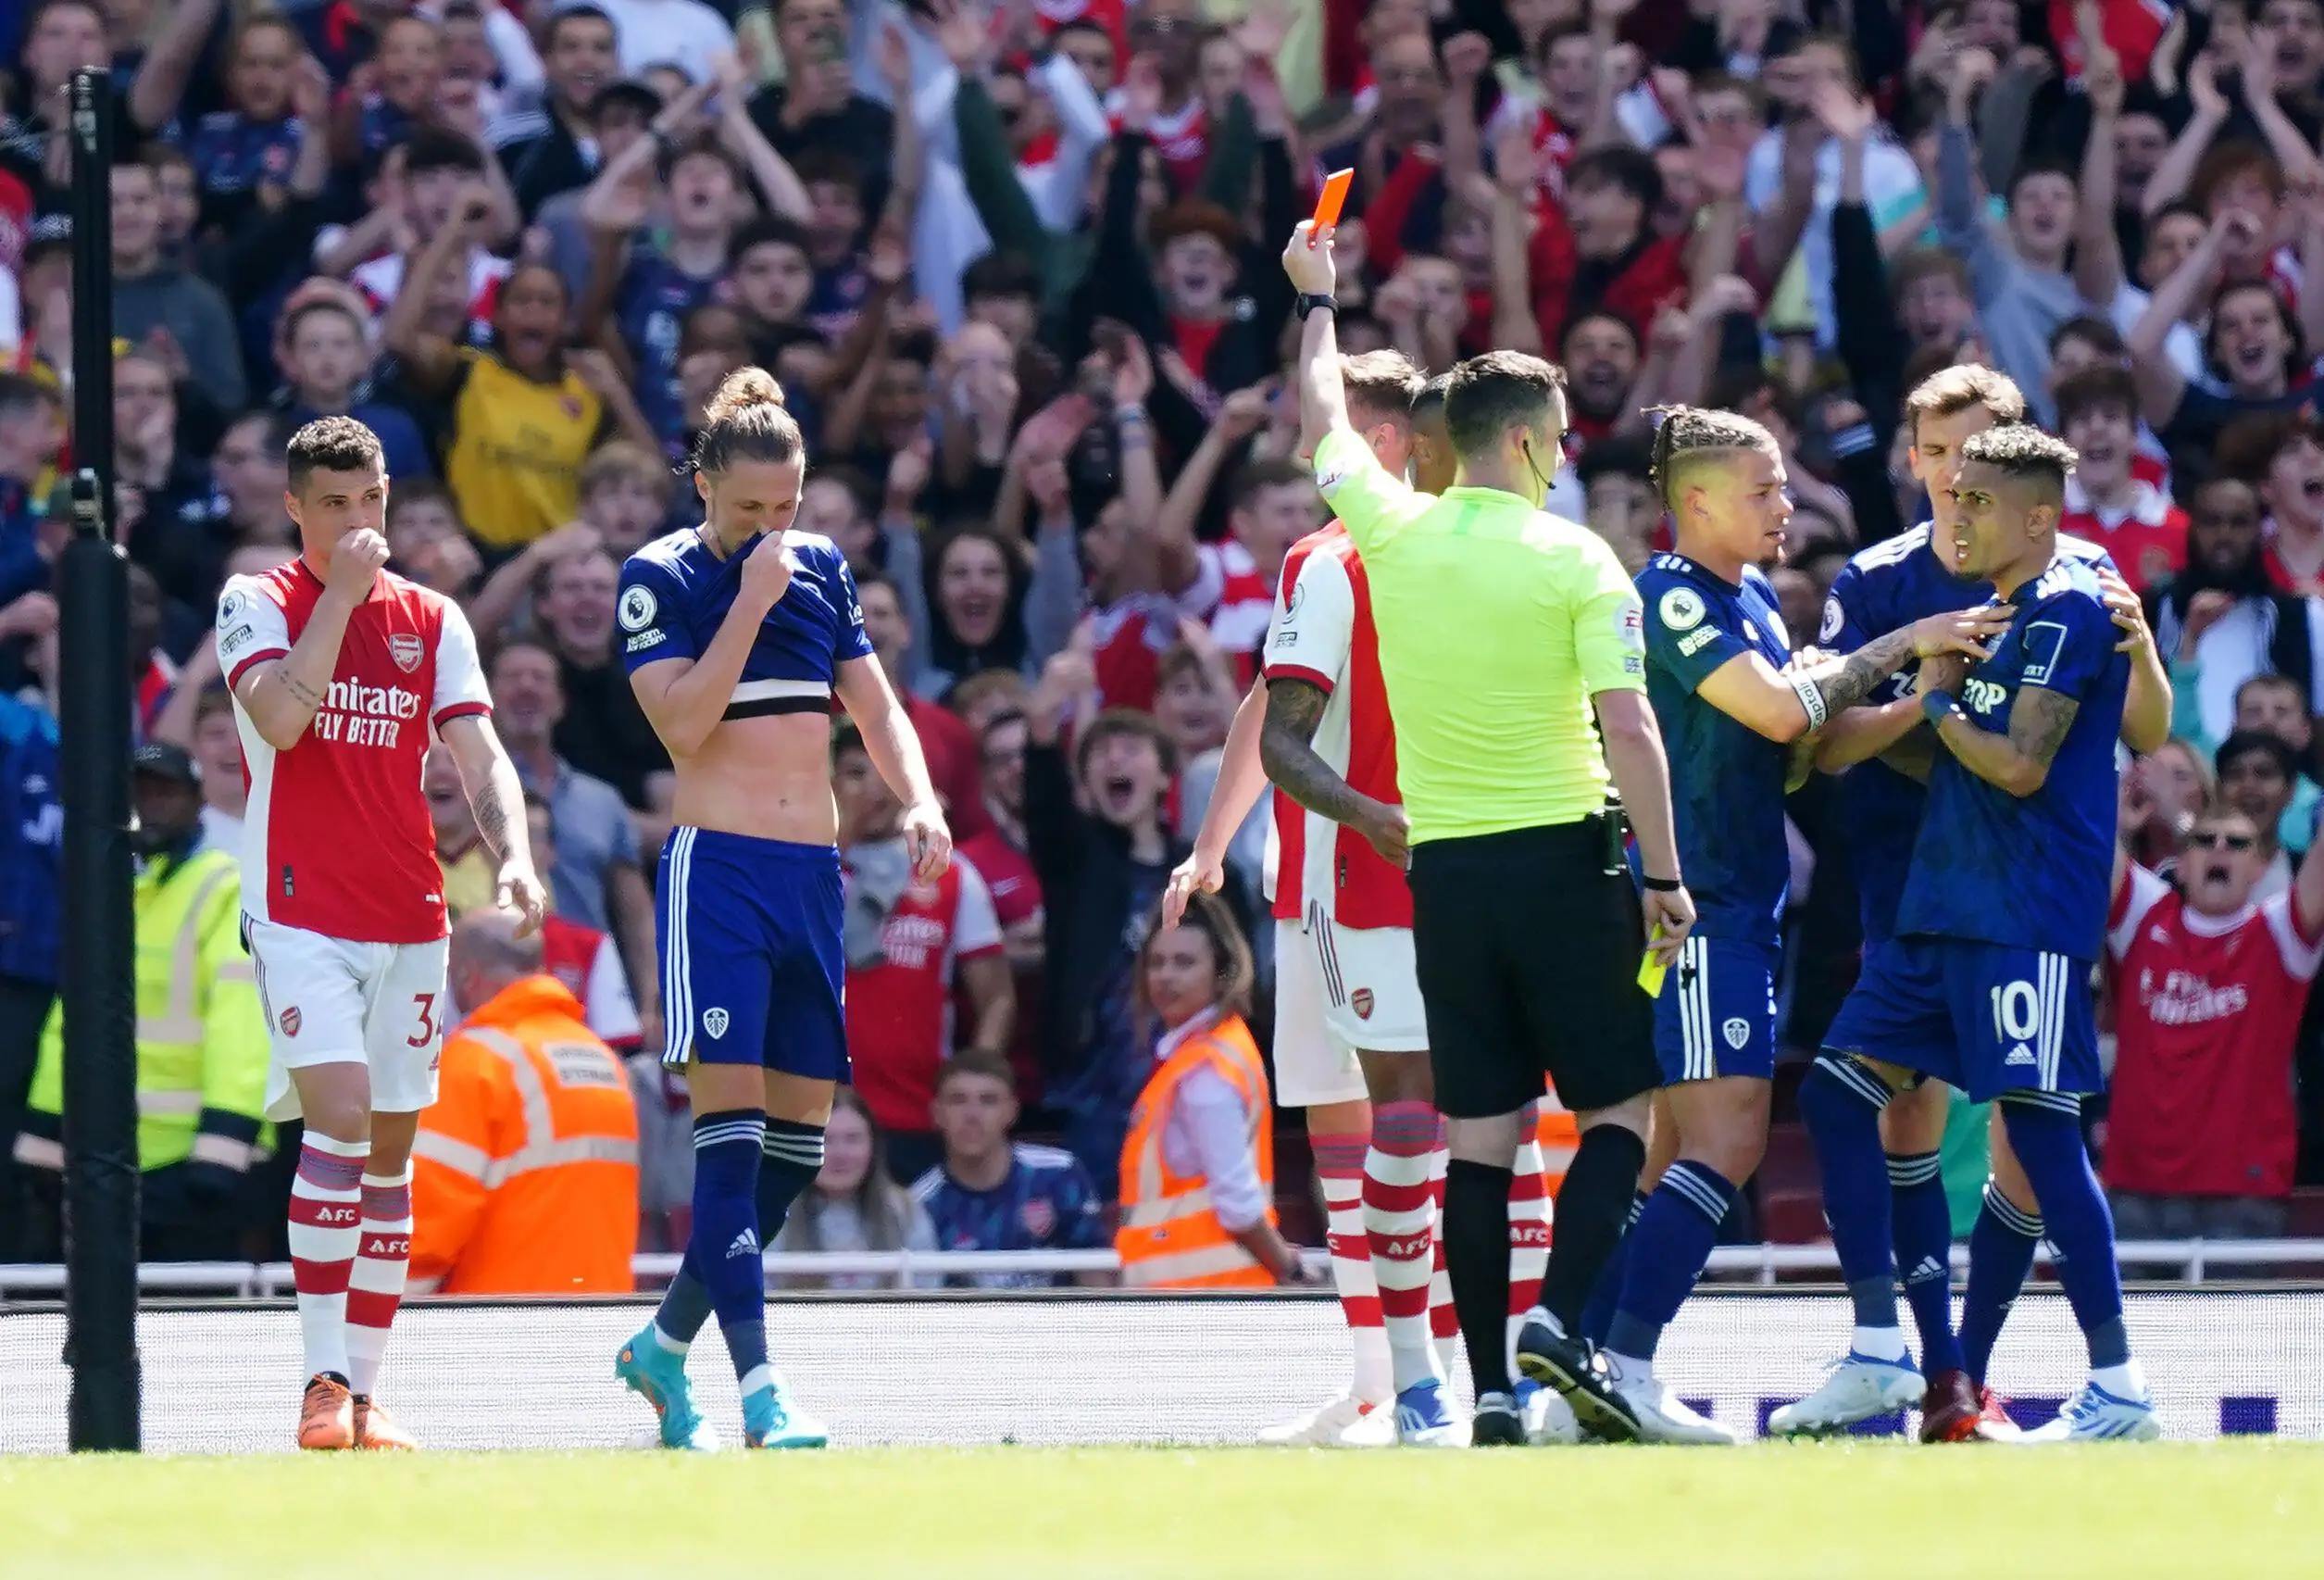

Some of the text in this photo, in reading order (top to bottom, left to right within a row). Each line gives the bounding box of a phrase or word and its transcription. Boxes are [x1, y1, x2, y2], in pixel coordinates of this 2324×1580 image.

[319, 675, 421, 720] mirates
[314, 711, 344, 741] FLY
[1991, 981, 2039, 1044] 10
[316, 1207, 356, 1222] AFC
[1388, 1235, 1430, 1255] AFC
[1510, 1227, 1549, 1243] AFC
[369, 1239, 409, 1253] AFC
